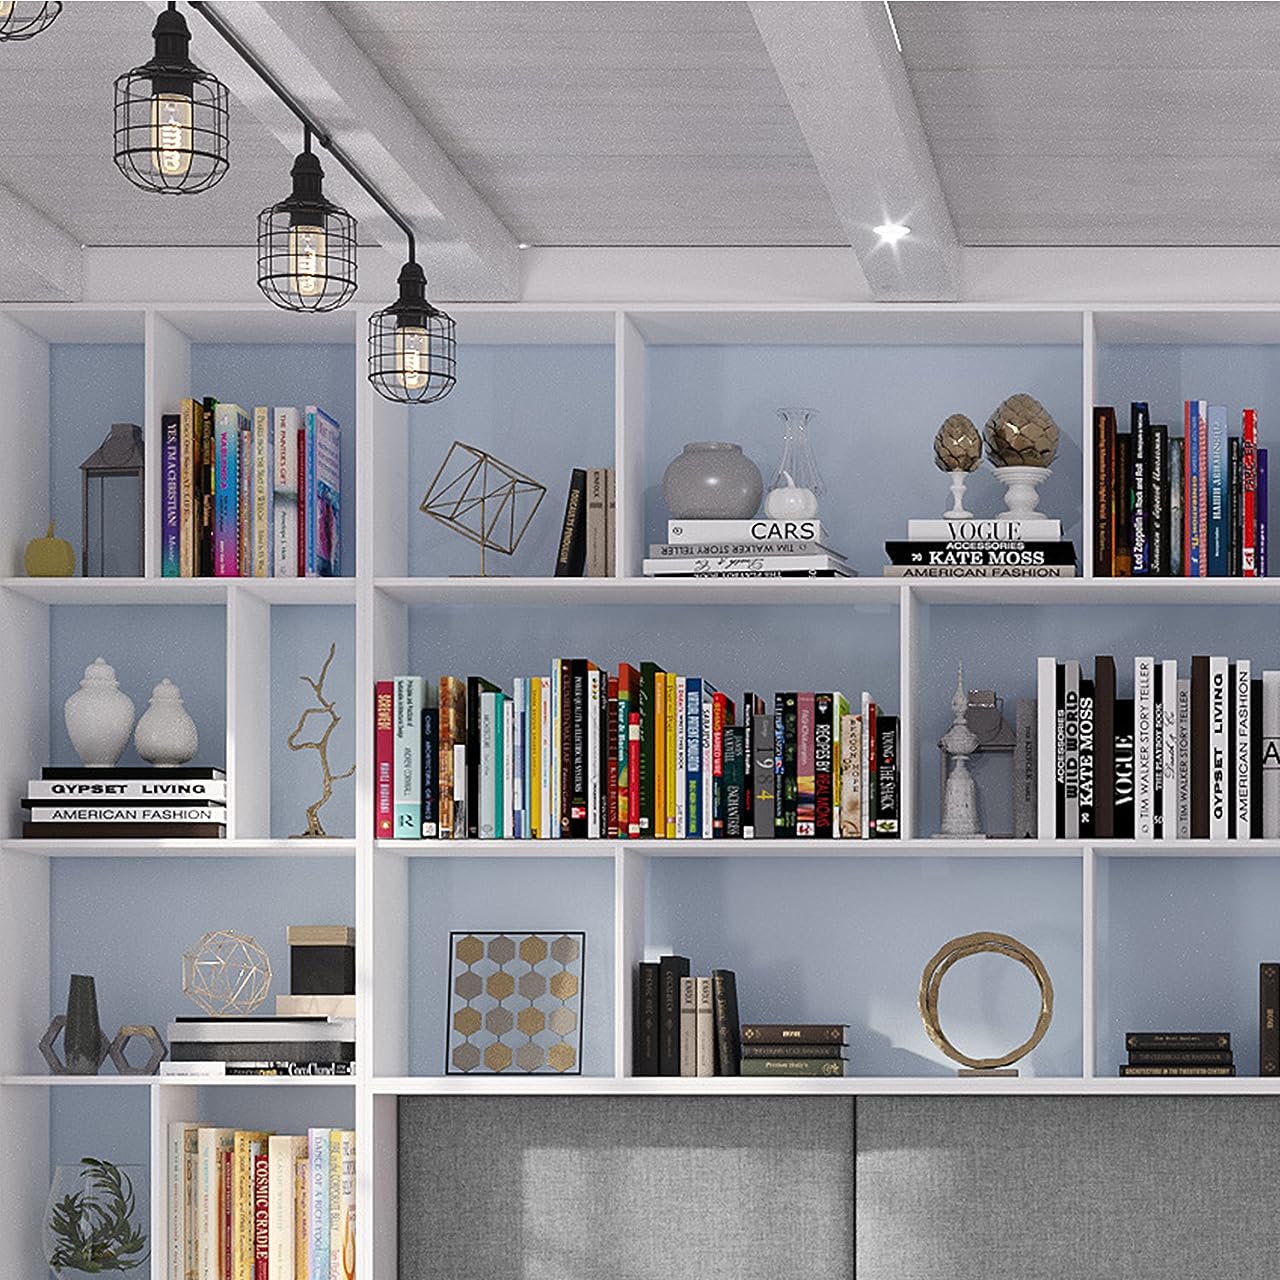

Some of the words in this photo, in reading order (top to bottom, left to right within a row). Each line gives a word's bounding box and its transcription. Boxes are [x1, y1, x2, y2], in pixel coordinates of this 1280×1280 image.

[1134, 463, 1143, 477] Roll
[1135, 490, 1143, 508] Rock
[751, 523, 815, 540] CARS
[948, 522, 1021, 540] VOGUE
[1134, 517, 1145, 553] Zeppelin
[661, 547, 694, 555] TELLER
[697, 546, 731, 555] STORY
[929, 552, 983, 565] KATE
[988, 552, 1045, 565] MOSS
[1134, 554, 1143, 570] Led
[903, 568, 986, 577] AMERICAN
[992, 568, 1060, 577] FASHION
[1140, 663, 1149, 701] TELLER
[1180, 691, 1188, 723] TELLER
[1214, 673, 1223, 734] LIVING
[1239, 671, 1248, 737] FASHION
[1066, 691, 1077, 752] WORLD
[1080, 697, 1093, 751] MOSS
[1140, 705, 1149, 743] STORY
[816, 724, 830, 760] RECIPES
[1180, 726, 1188, 758] STORY
[816, 761, 830, 773] BY
[880, 765, 895, 782] THE
[1066, 757, 1077, 799] WILD
[1080, 755, 1093, 807] KATE
[1115, 735, 1133, 806] VOGUE
[1140, 746, 1149, 796] WALKER
[1180, 760, 1188, 801] WALKER
[1239, 743, 1248, 822] AMERICAN
[51, 785, 128, 794] GYPSET
[142, 785, 206, 794] LIVING
[816, 774, 830, 794] REAL
[880, 782, 895, 811] SHACK
[1214, 747, 1223, 820] GYPSET
[52, 810, 137, 819] AMERICAN
[142, 810, 211, 819] FASHION
[816, 797, 830, 827] MOMS
[1140, 798, 1149, 818] TIM
[1180, 804, 1188, 822] TIM
[255, 1160, 268, 1208] COSMIC
[255, 1210, 268, 1259] CRADLE
